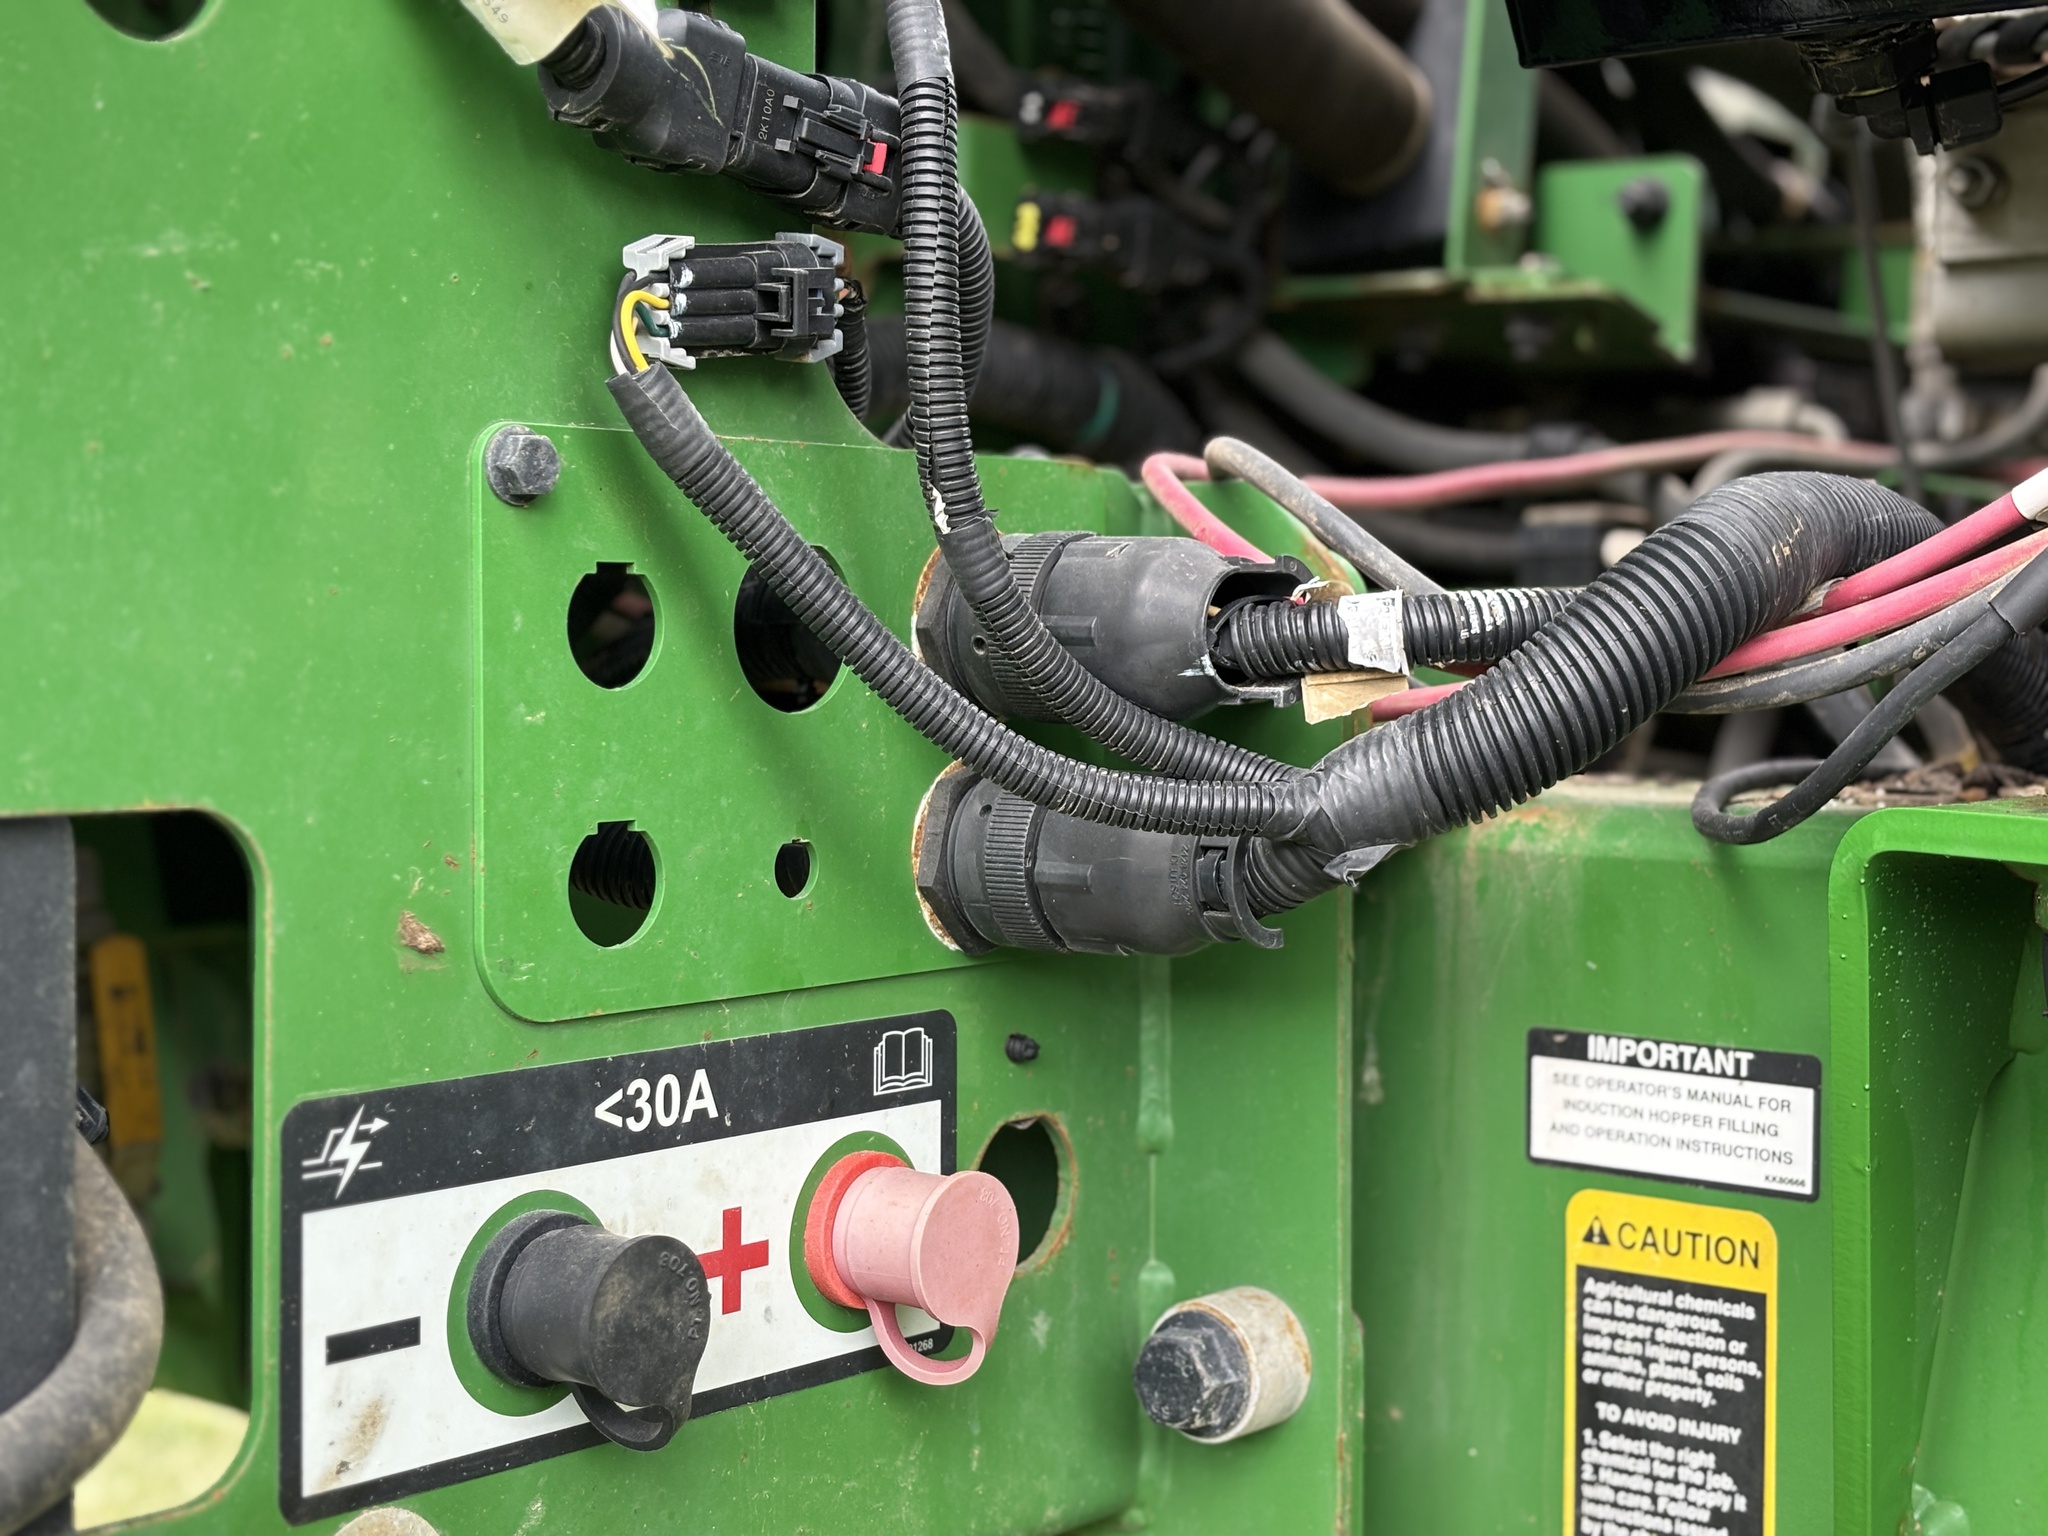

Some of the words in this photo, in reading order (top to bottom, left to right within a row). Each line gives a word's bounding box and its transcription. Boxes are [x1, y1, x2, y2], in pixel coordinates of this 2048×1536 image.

[757, 88, 776, 141] 2K10A0
[1587, 1034, 1755, 1078] IMPORTANT
[592, 1067, 720, 1133] <30A
[1552, 1072, 1581, 1088] SEE
[1585, 1075, 1682, 1099] OPERATOR'S
[1686, 1089, 1753, 1109] MANUAL
[1758, 1096, 1791, 1113] FOR
[1562, 1099, 1644, 1120] INDUCTION
[1648, 1110, 1713, 1130] HOPPER
[1718, 1118, 1779, 1138] FILLING
[1550, 1121, 1580, 1137] AND
[1585, 1126, 1671, 1149] OPERATION
[1675, 1138, 1794, 1166] INSTRUCTIONS
[1618, 1221, 1760, 1269] CAUTION
[1582, 1297, 1611, 1315] can
[1613, 1300, 1635, 1319] be
[1636, 1305, 1725, 1334] dangerous.
[1583, 1276, 1673, 1307] Agricultural
[1675, 1293, 1756, 1321] chemicals
[1582, 1313, 1653, 1340] Improper
[1654, 1326, 1726, 1352] selection
[1728, 1340, 1747, 1355] or
[1582, 1333, 1611, 1350] use
[1613, 1339, 1643, 1356] can
[1645, 1341, 1690, 1365] injure
[1692, 1351, 1763, 1379] persons,
[1581, 1368, 1600, 1384] or
[1601, 1373, 1644, 1392] other
[1645, 1379, 1717, 1409] property.
[1582, 1350, 1647, 1376] animals,
[1648, 1362, 1702, 1386] plants,
[1704, 1372, 1745, 1392] soils
[1595, 1401, 1621, 1423] TO
[1622, 1407, 1676, 1433] AVOID
[1678, 1417, 1742, 1445] INJURY
[1581, 1447, 1650, 1475] chemical
[1652, 1458, 1676, 1480] for
[1677, 1464, 1705, 1488] the
[1706, 1470, 1738, 1492] job.
[1582, 1428, 1598, 1446] 1.
[1598, 1430, 1647, 1456] Select
[1648, 1440, 1676, 1462] the
[1677, 1446, 1716, 1470] right
[1581, 1464, 1597, 1482] 2.
[1598, 1466, 1654, 1493] Handle
[1654, 1478, 1686, 1499] and
[1687, 1486, 1733, 1513] apply
[1734, 1492, 1748, 1512] it
[1581, 1483, 1615, 1502] with
[1616, 1491, 1655, 1511] care.
[1657, 1496, 1711, 1523] Follow
